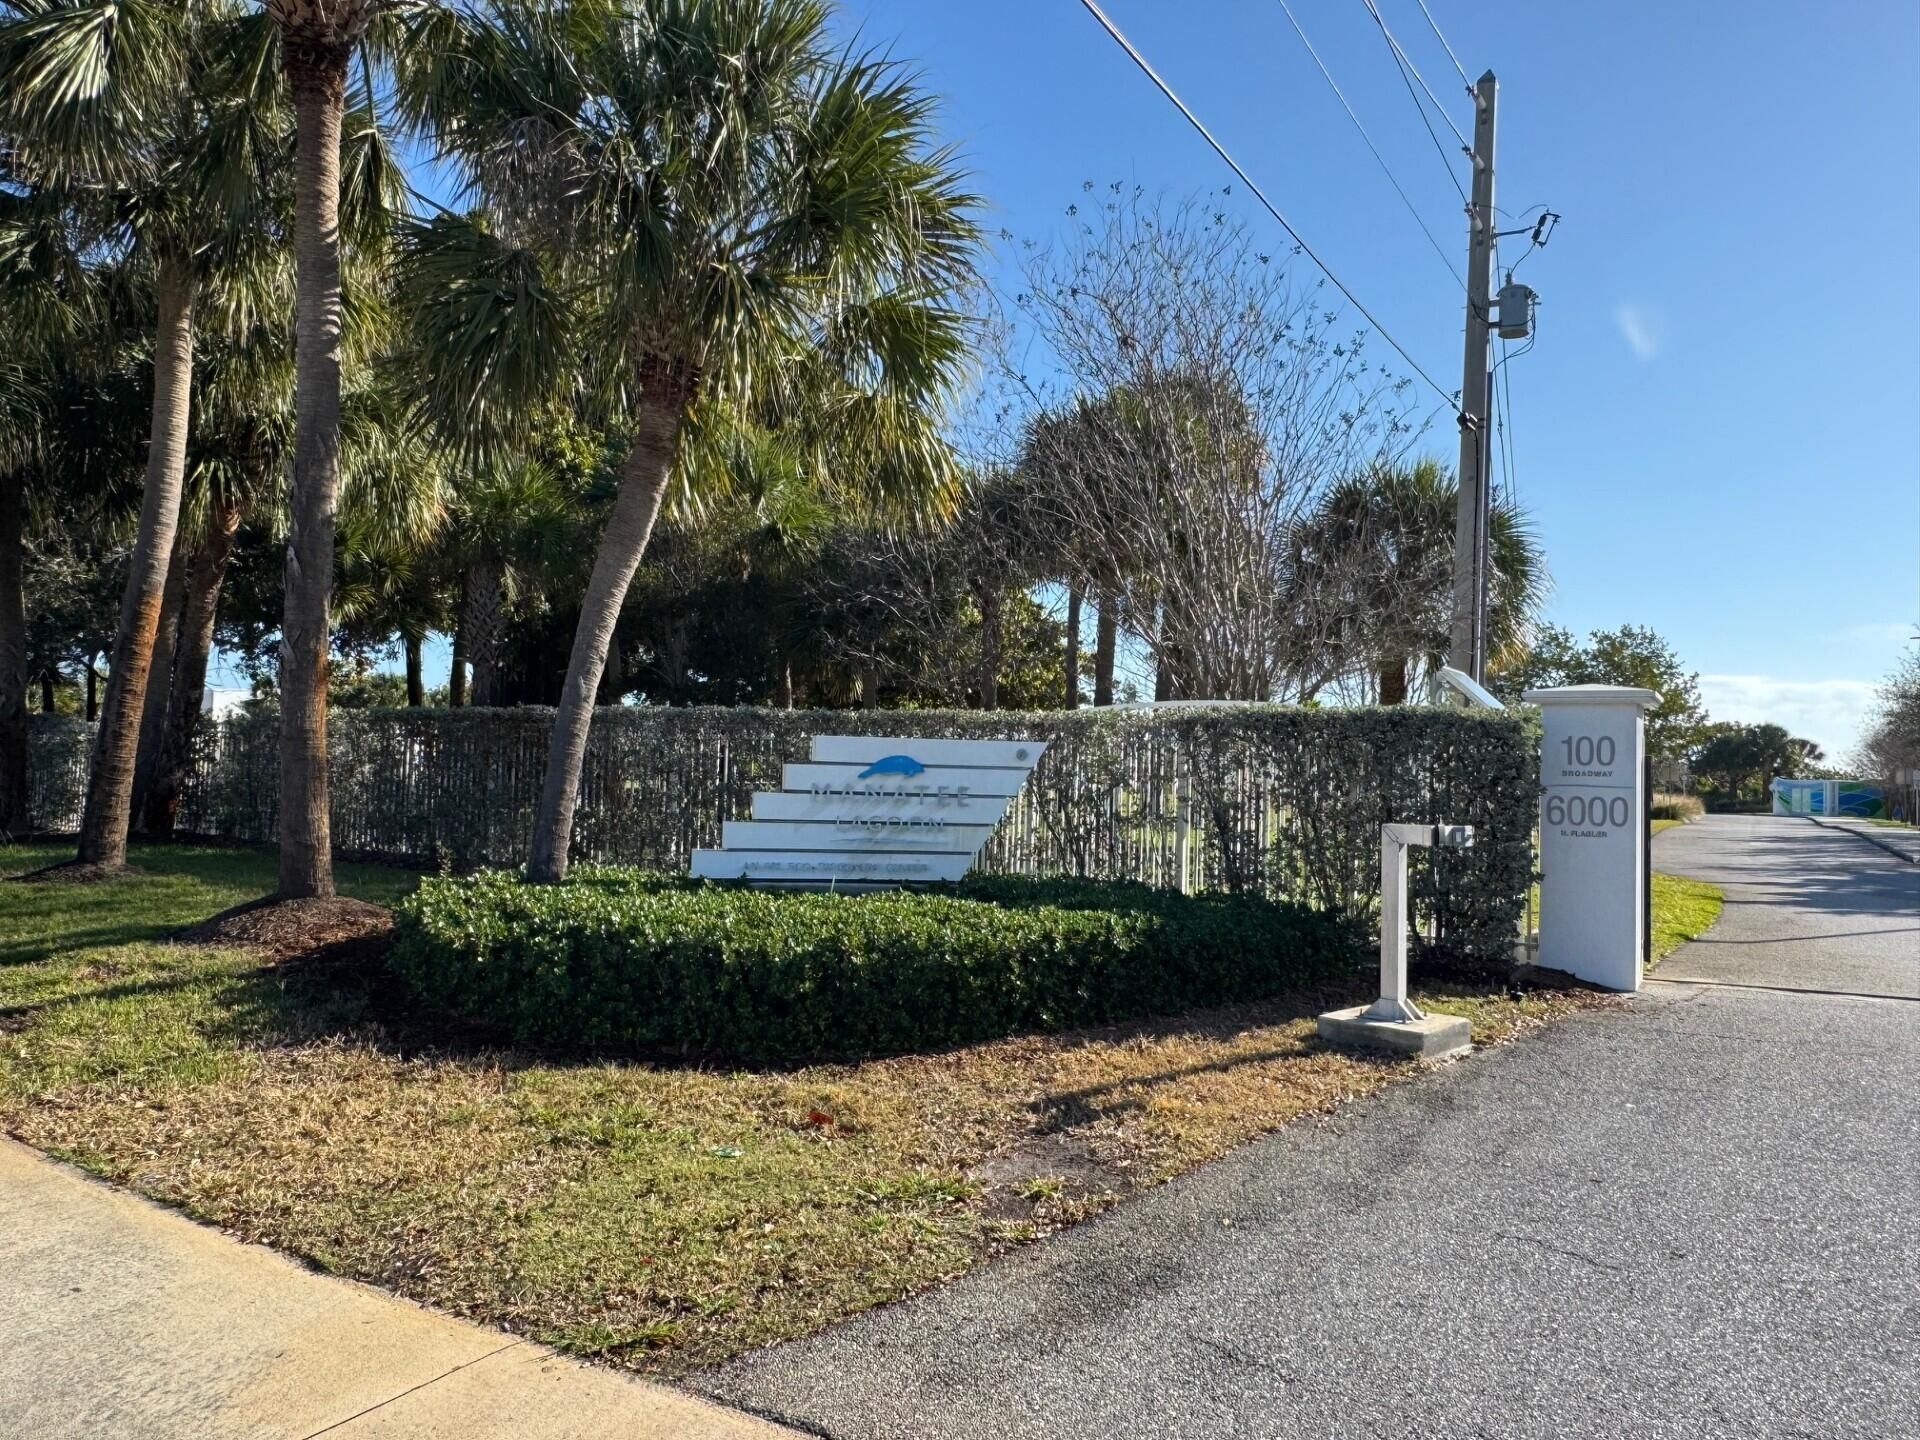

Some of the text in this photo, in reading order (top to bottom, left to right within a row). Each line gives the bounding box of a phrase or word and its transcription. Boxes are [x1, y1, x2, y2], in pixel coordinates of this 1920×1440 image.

[1561, 735, 1616, 766] 100
[810, 782, 971, 807] MANATEE
[1546, 795, 1629, 828] 6000
[1570, 830, 1608, 838] FLAGLER
